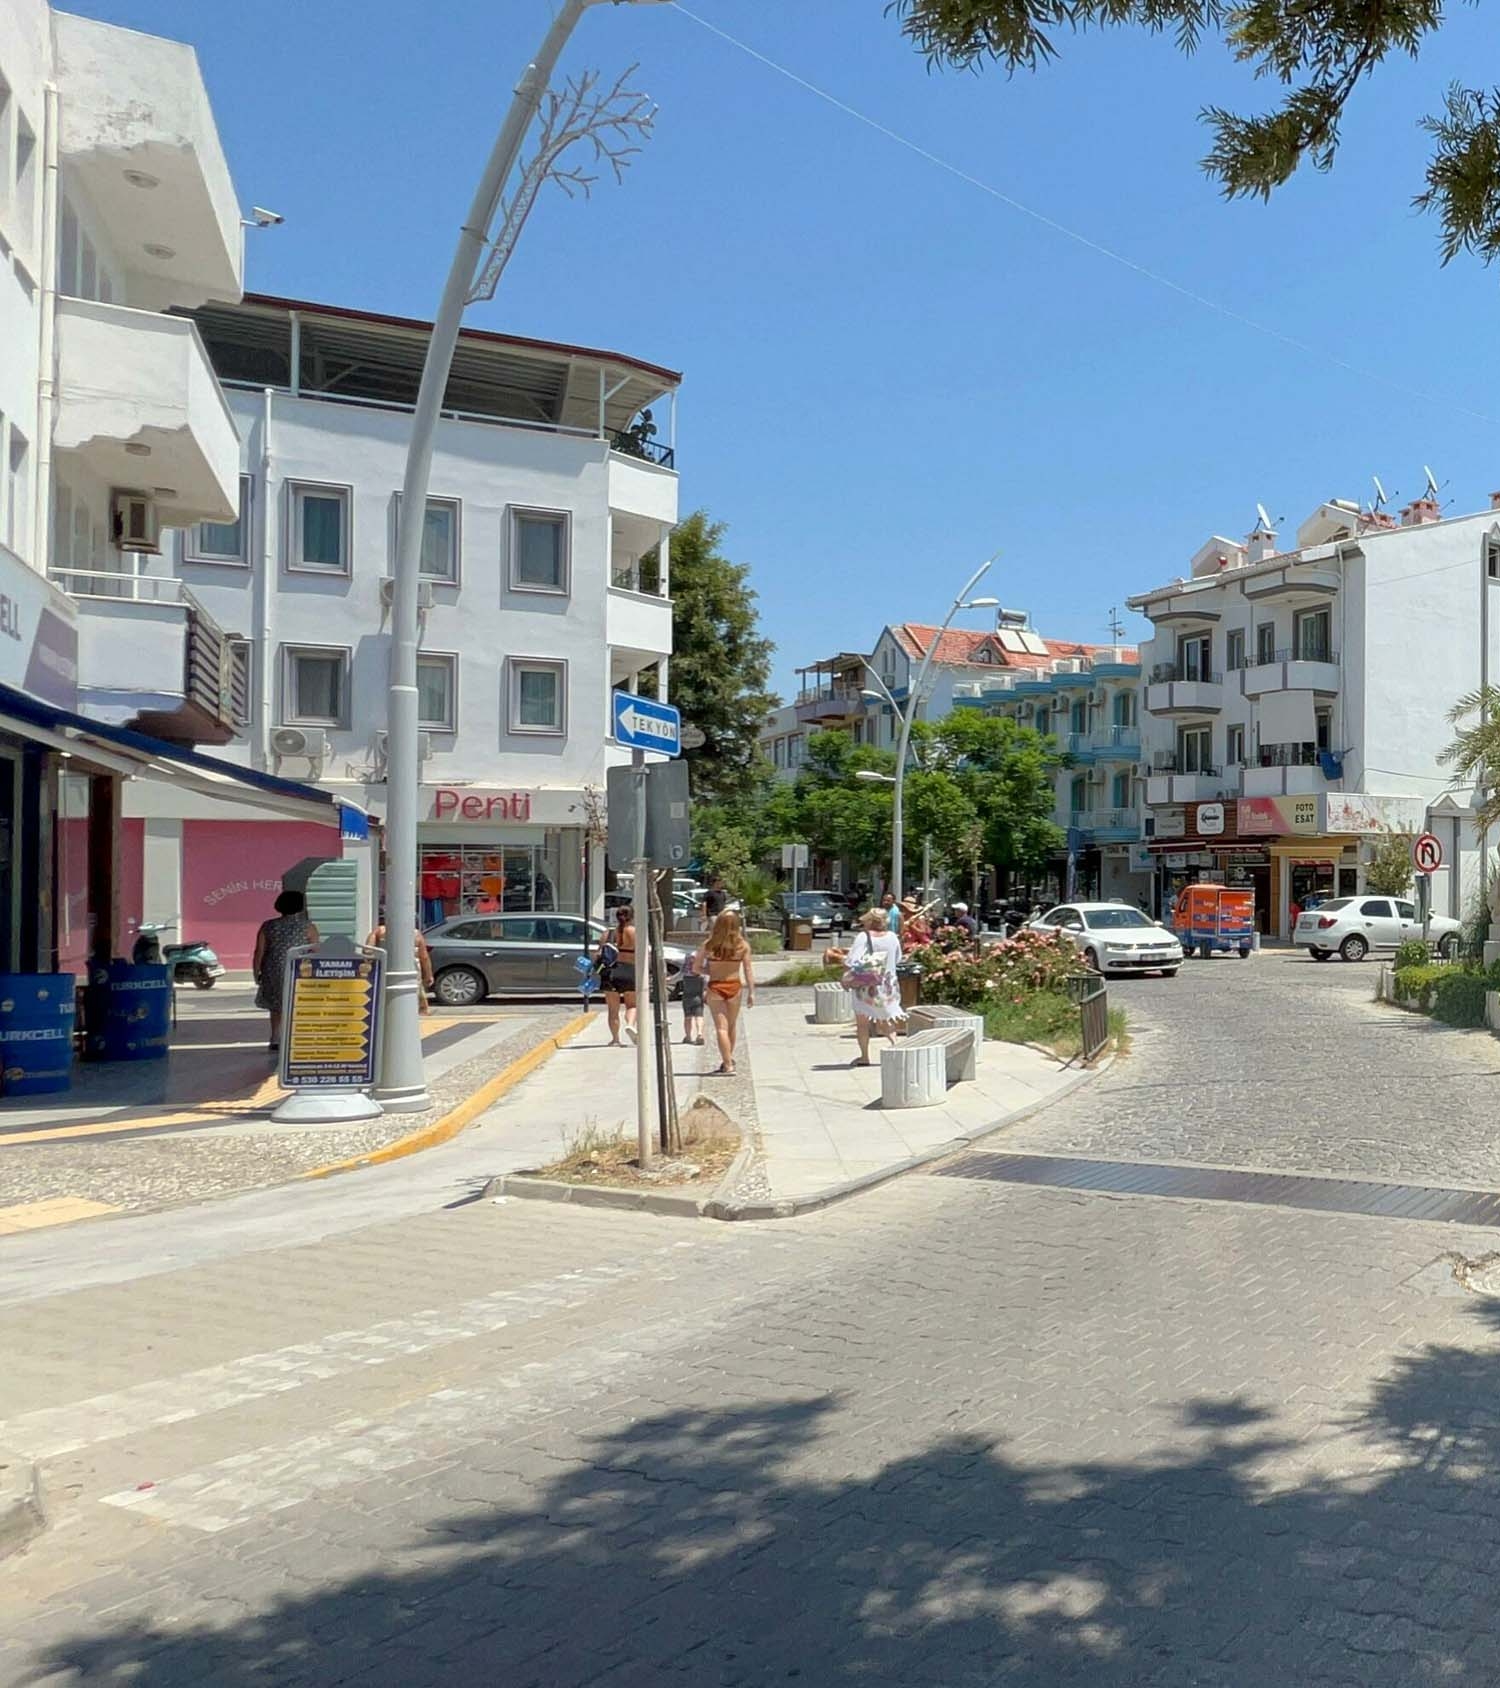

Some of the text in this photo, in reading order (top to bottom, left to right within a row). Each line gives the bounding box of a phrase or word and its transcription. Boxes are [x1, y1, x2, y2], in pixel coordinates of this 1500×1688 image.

[632, 716, 653, 733] TEK
[655, 721, 676, 738] YÖN
[436, 790, 531, 819] Penti
[1295, 803, 1314, 812] FOTO
[1295, 814, 1314, 824] ESAT
